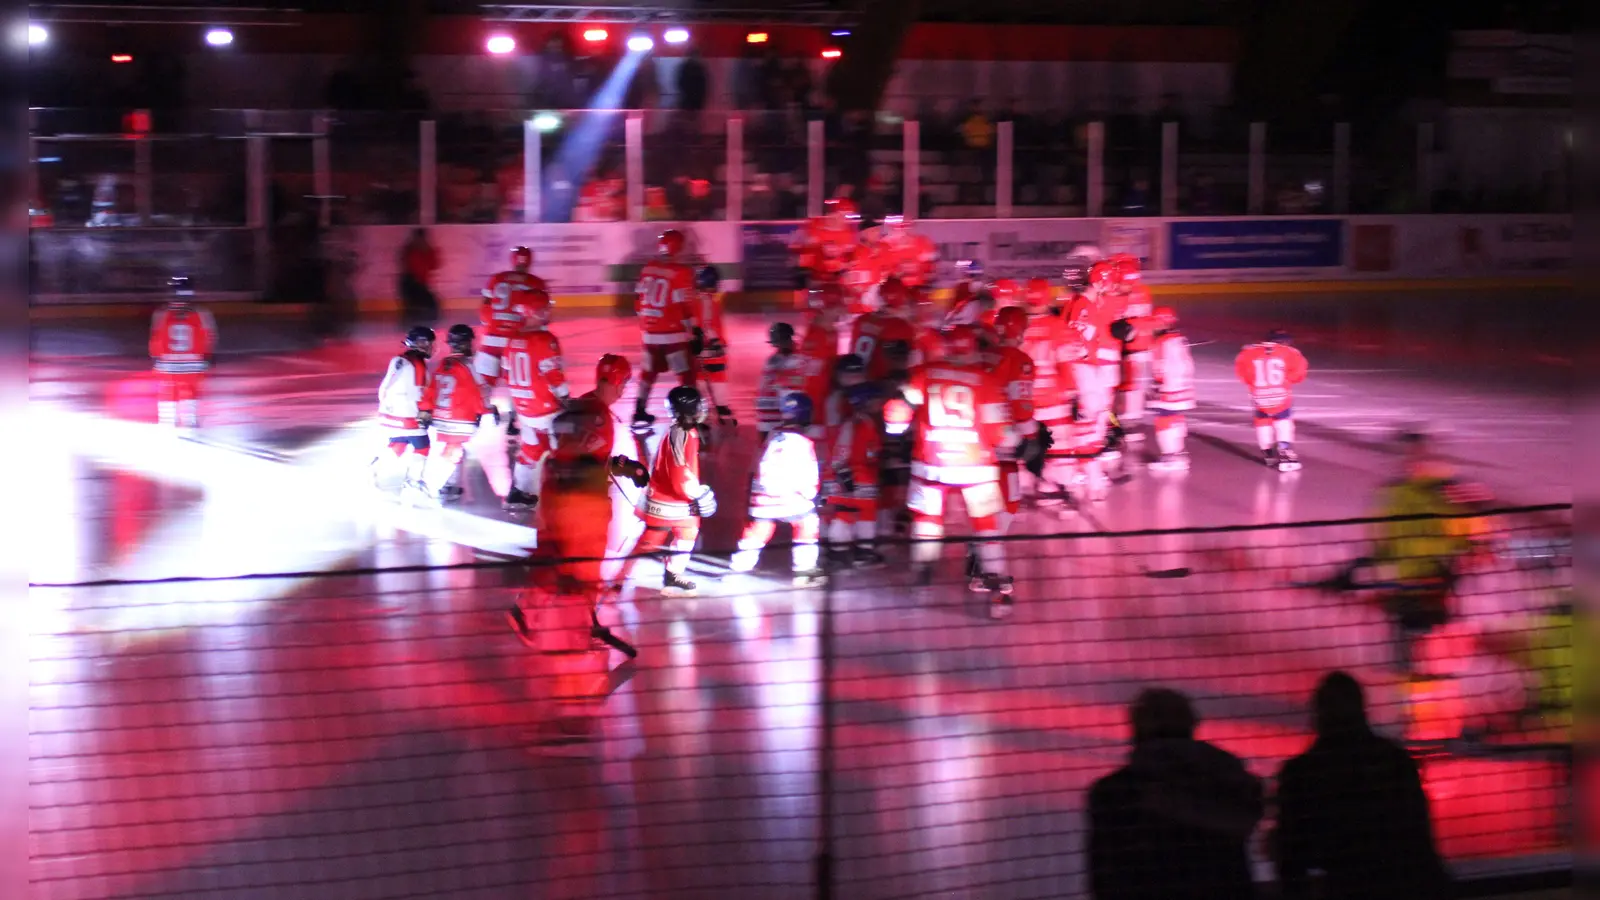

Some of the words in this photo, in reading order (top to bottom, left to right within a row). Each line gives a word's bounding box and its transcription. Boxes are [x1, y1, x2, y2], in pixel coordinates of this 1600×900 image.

[167, 324, 194, 352] 9
[1252, 358, 1286, 387] 16
[926, 382, 976, 428] 19
